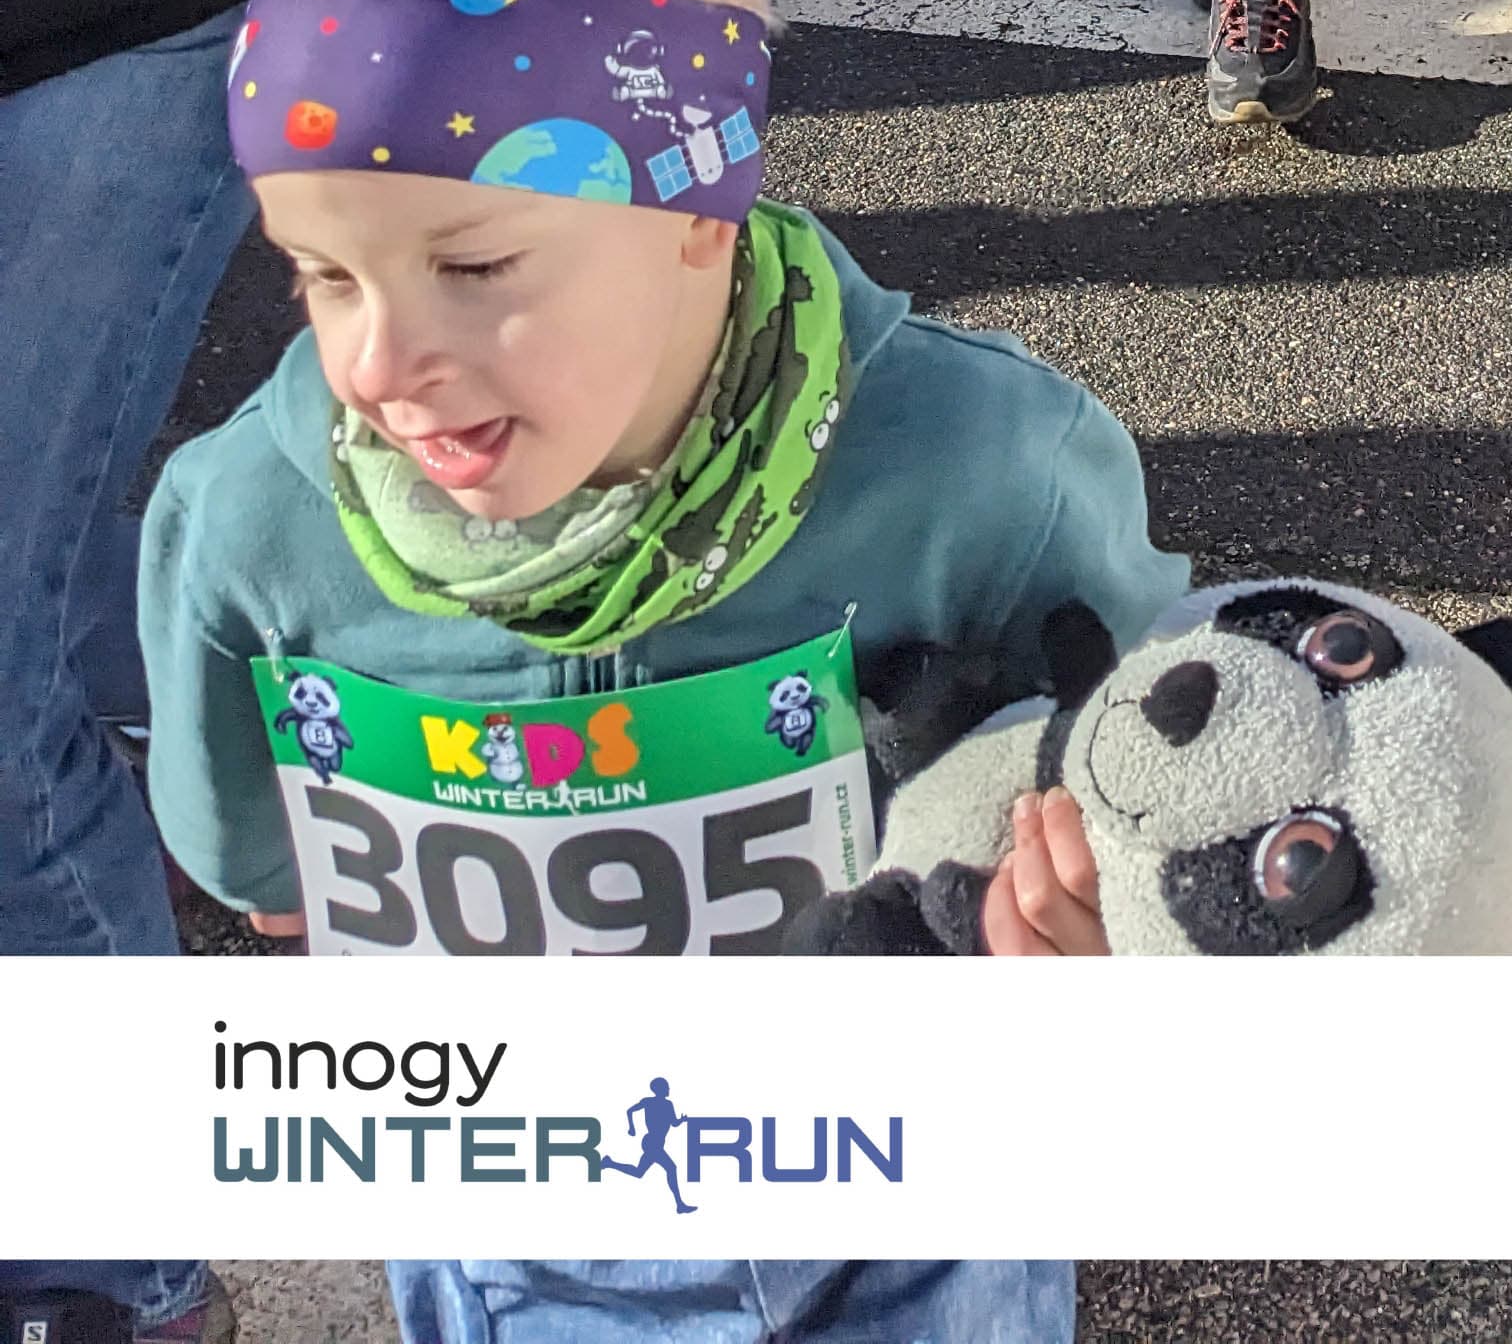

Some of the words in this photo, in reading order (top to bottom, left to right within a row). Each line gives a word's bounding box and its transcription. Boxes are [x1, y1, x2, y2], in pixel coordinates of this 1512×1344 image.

[420, 702, 642, 789] KIDS
[432, 780, 552, 812] WINTER
[574, 779, 648, 808] RUN
[305, 785, 828, 955] 3095
